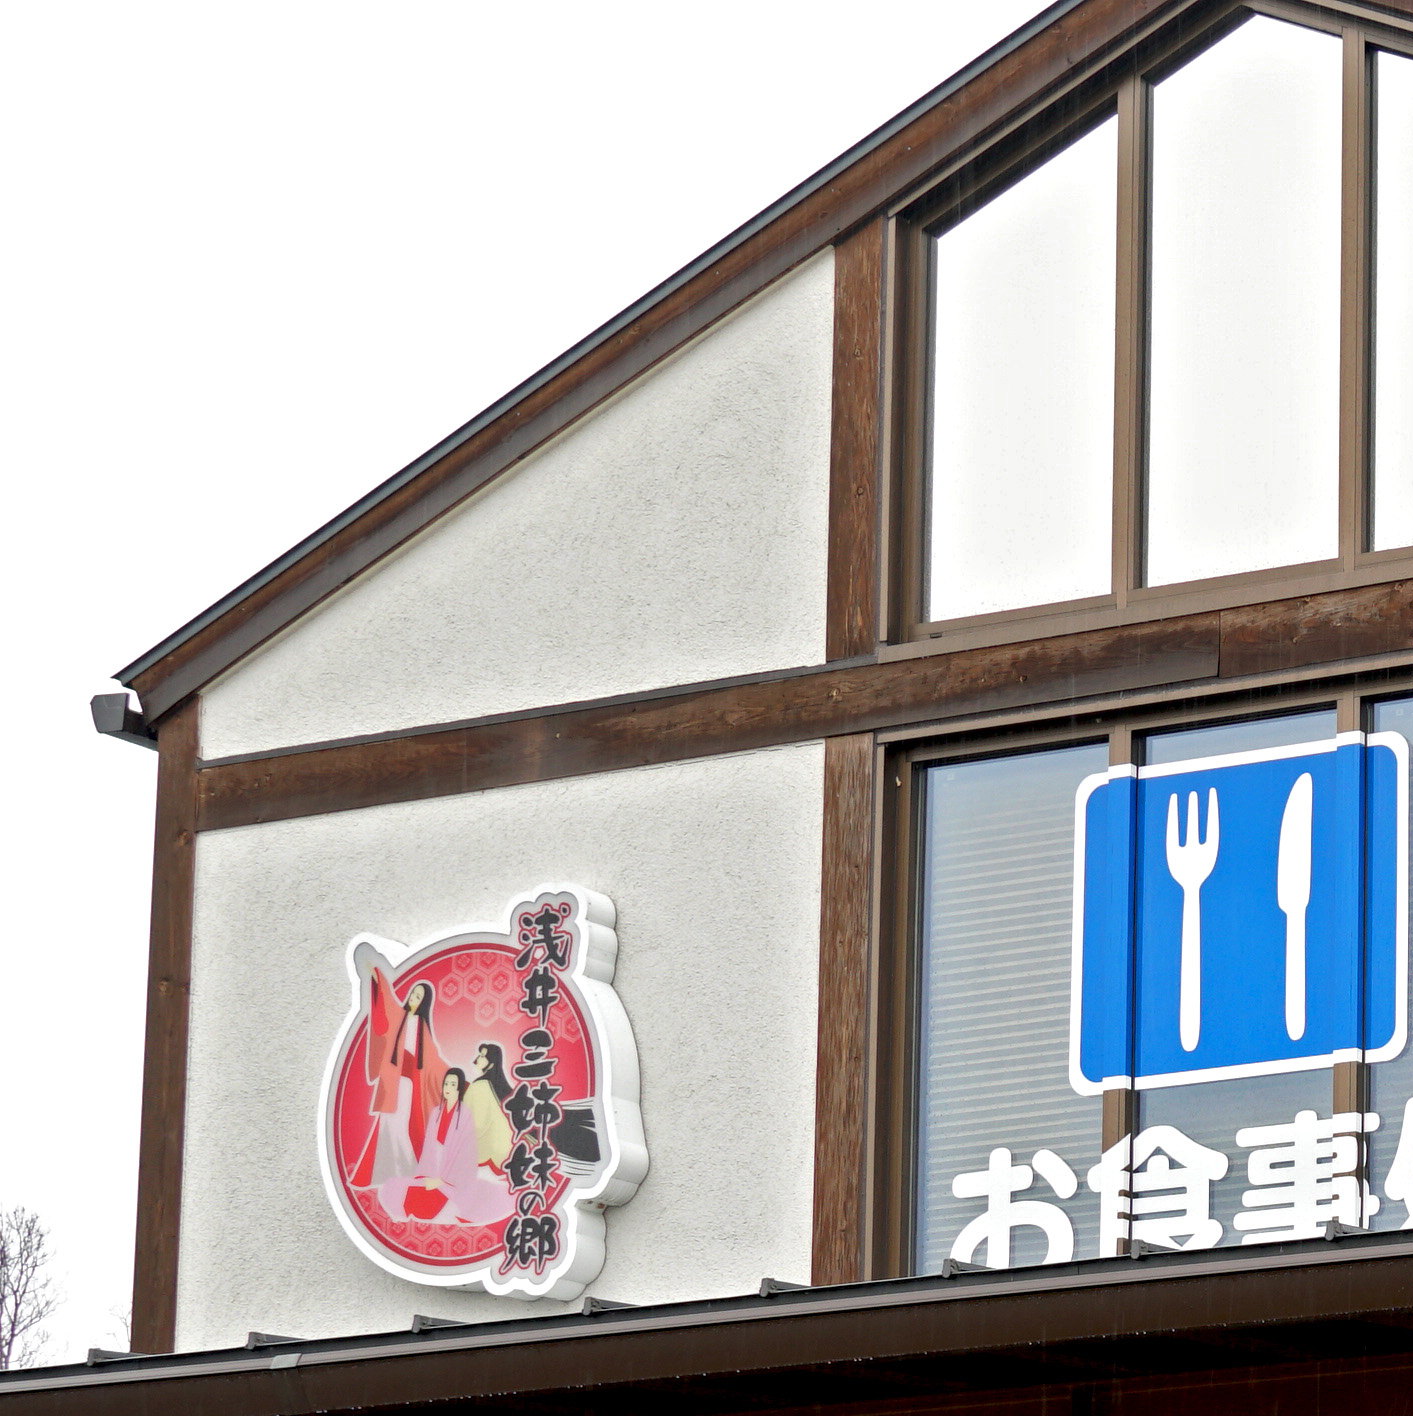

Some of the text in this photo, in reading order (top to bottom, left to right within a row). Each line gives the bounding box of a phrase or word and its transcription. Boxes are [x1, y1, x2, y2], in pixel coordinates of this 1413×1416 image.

[502, 902, 572, 1275] 浅井三姉妹の郷
